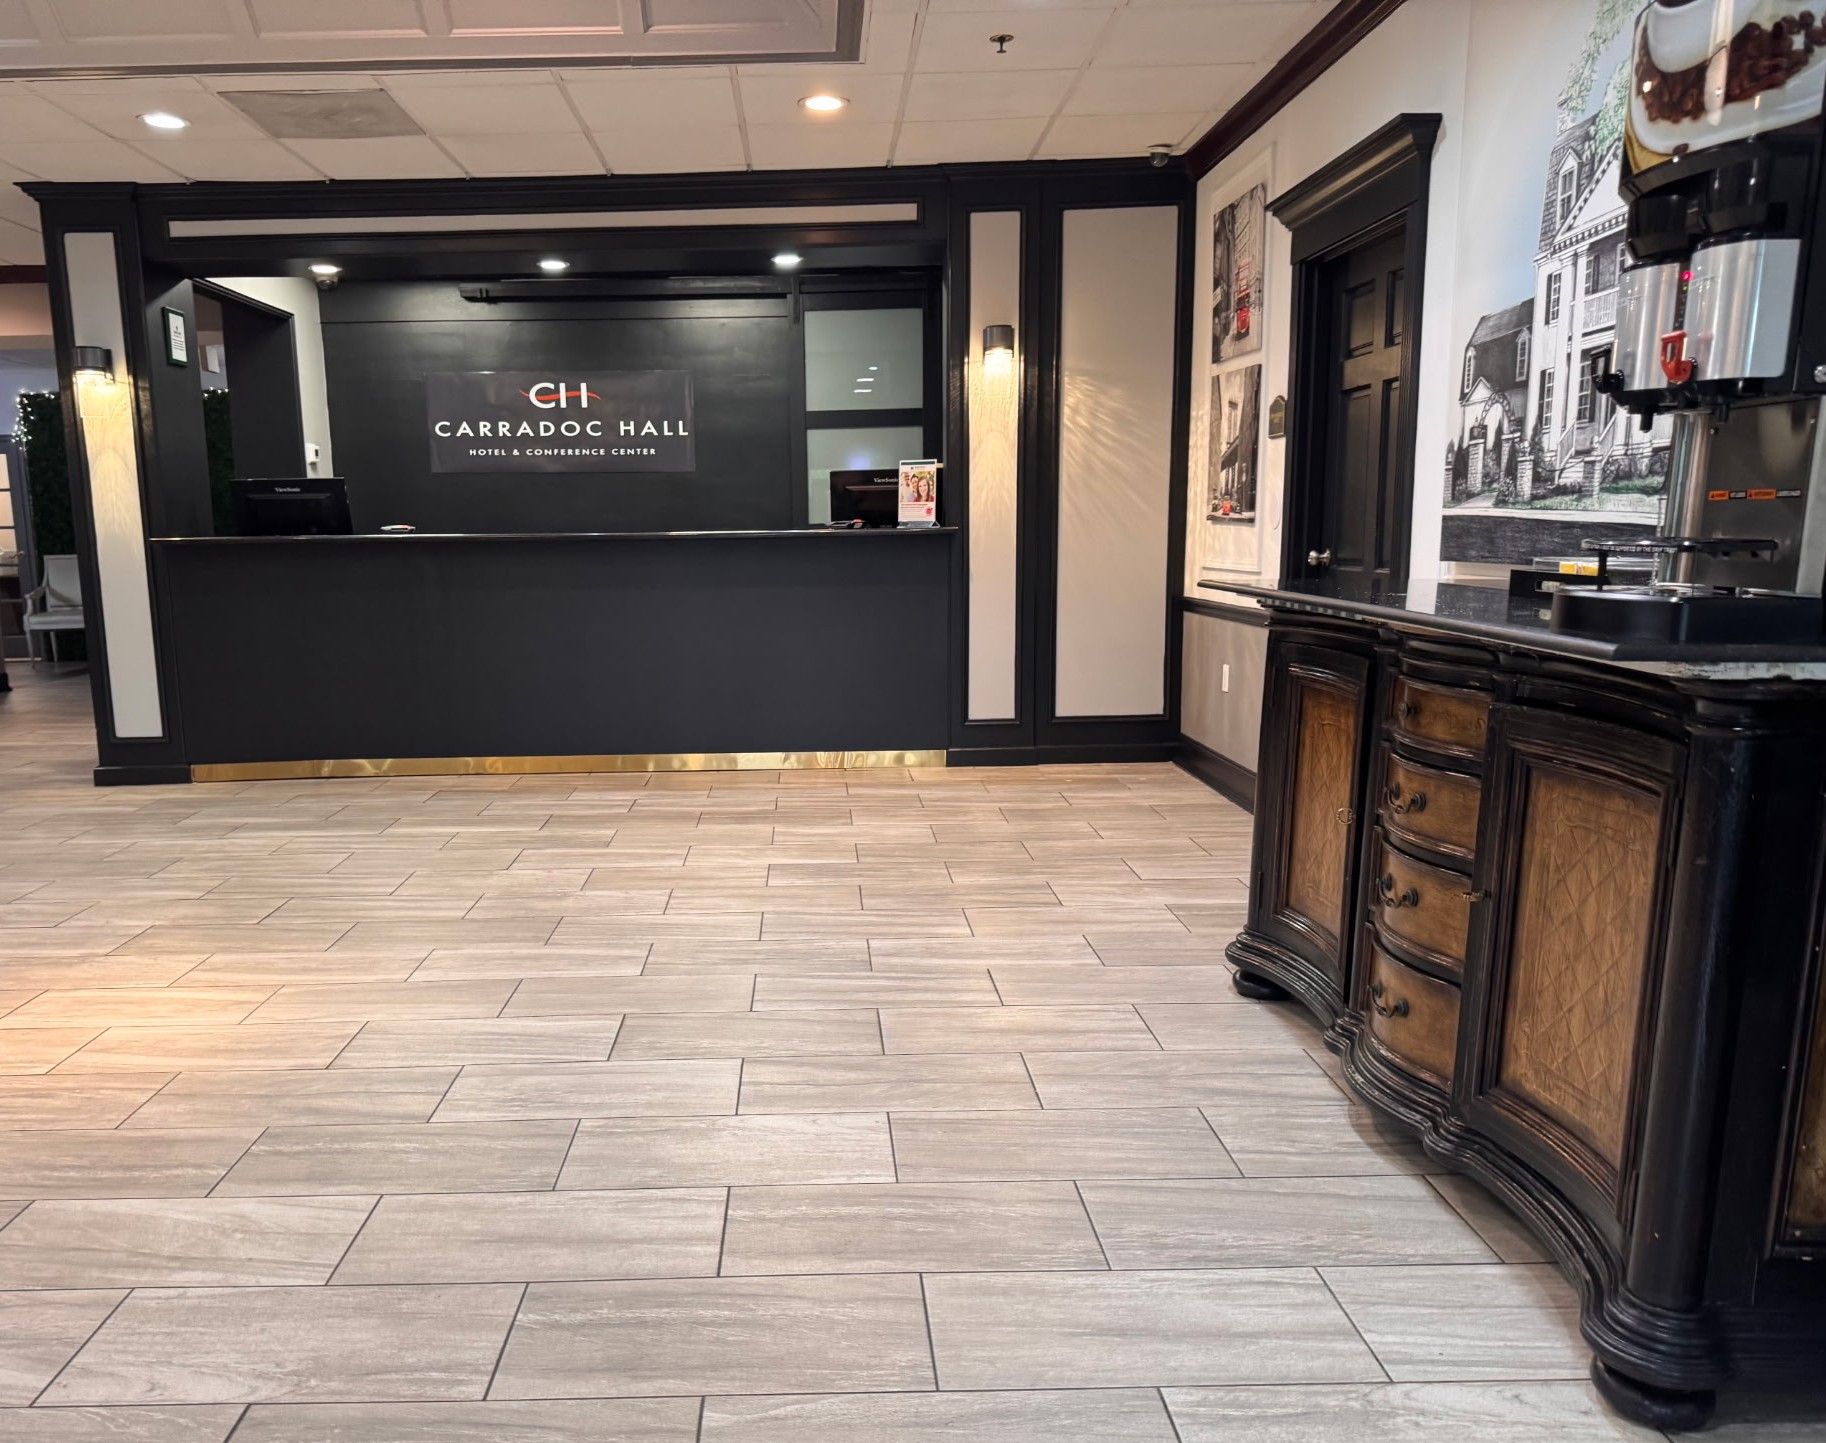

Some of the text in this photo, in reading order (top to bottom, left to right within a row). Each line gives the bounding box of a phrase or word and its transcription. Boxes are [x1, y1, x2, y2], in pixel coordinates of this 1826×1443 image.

[528, 382, 588, 409] CH
[434, 420, 689, 438] CARRADOC HALL
[469, 447, 657, 456] HOTEL & CONFERENCE CENTER
